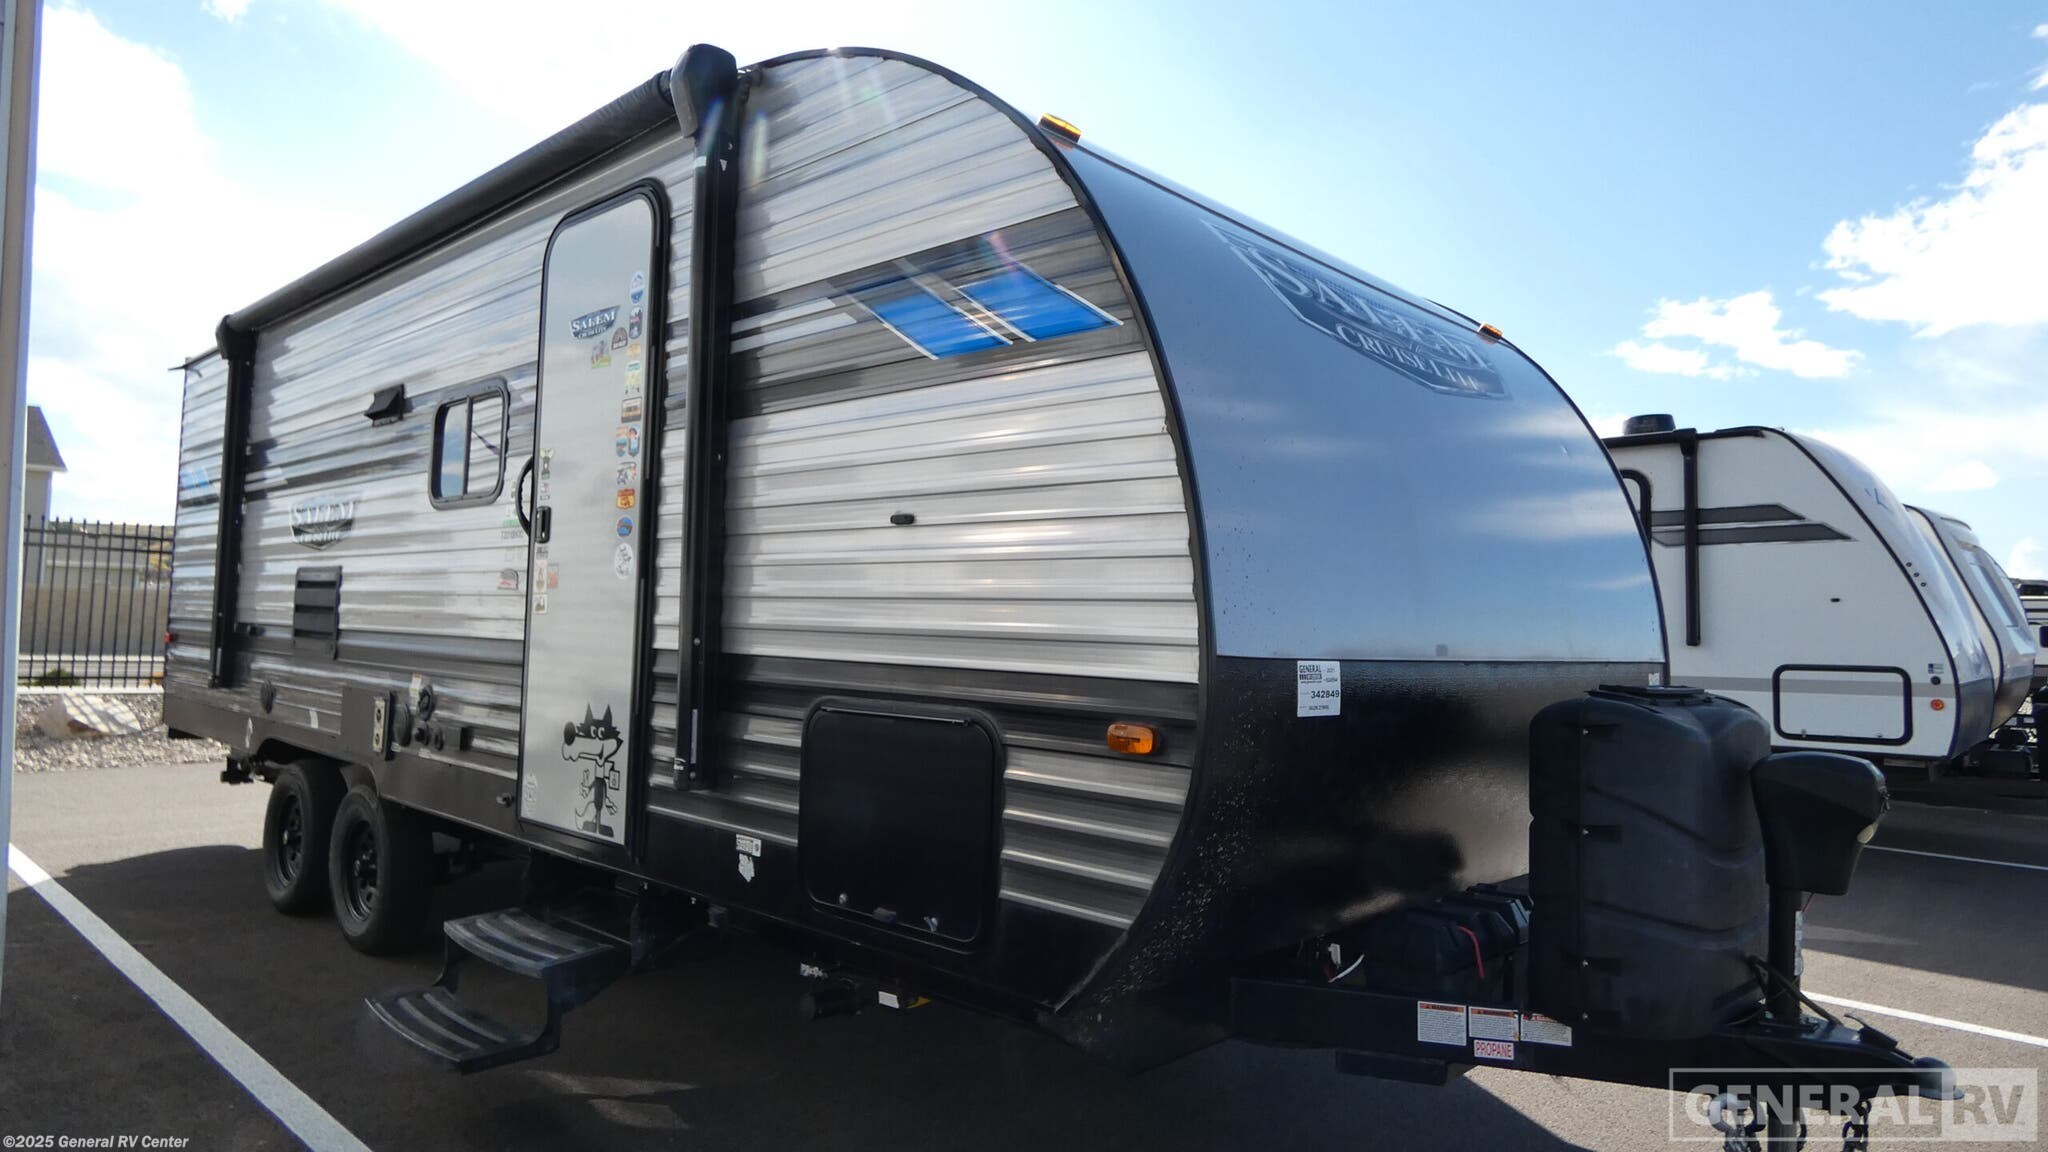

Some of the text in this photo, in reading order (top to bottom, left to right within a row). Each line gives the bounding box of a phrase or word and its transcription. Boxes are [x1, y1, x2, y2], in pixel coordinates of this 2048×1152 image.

[1246, 246, 1496, 373] SALEM
[572, 311, 616, 332] SALEM
[1311, 689, 1340, 699] 342849
[1475, 1041, 1513, 1058] PROPANE
